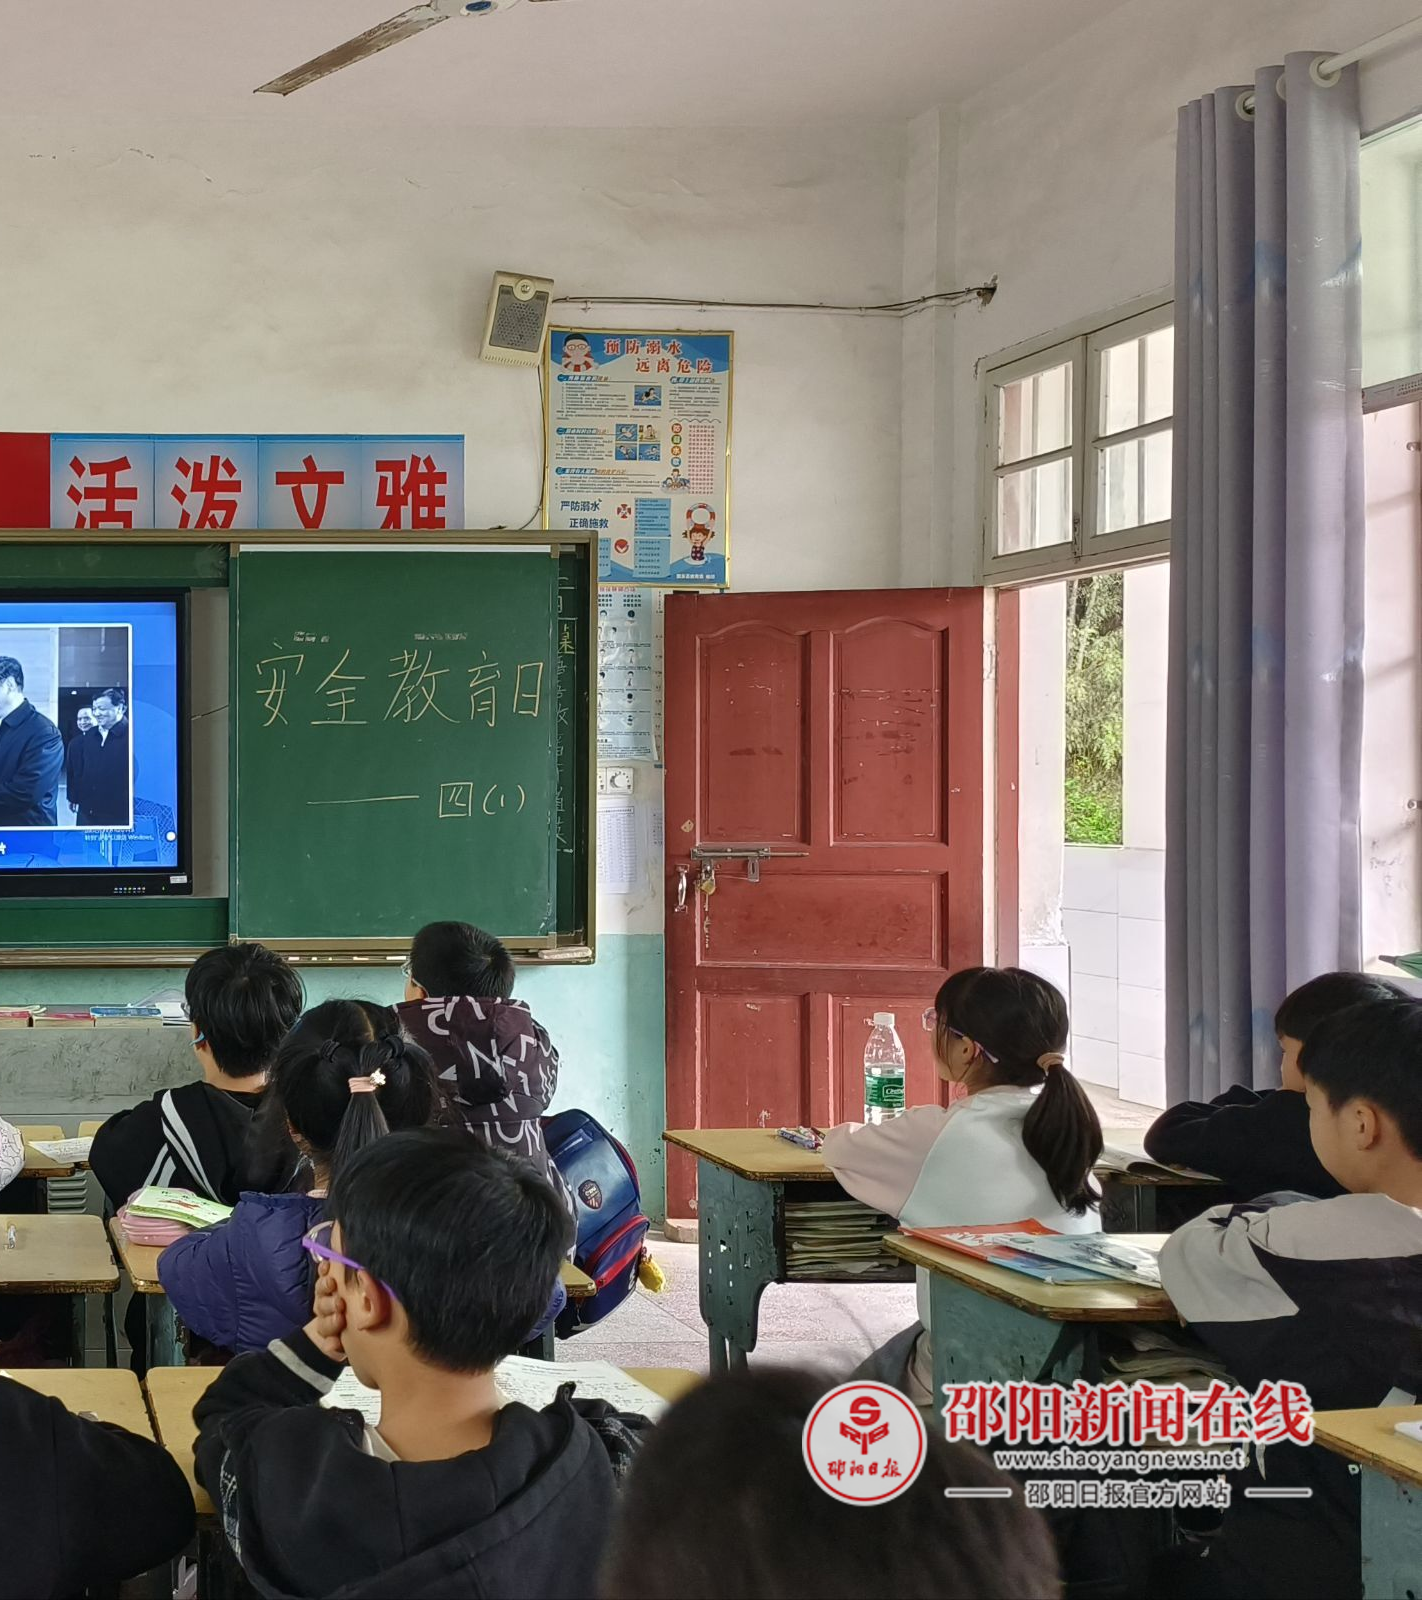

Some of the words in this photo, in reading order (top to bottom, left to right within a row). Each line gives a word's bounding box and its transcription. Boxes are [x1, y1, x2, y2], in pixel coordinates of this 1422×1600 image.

[604, 338, 682, 355] 预防溺水
[635, 357, 713, 374] 远离危险
[66, 454, 447, 529] 活泼文雅
[560, 500, 600, 512] 严防溺水
[569, 518, 609, 529] 正确施救
[256, 639, 544, 727] 安全教育日
